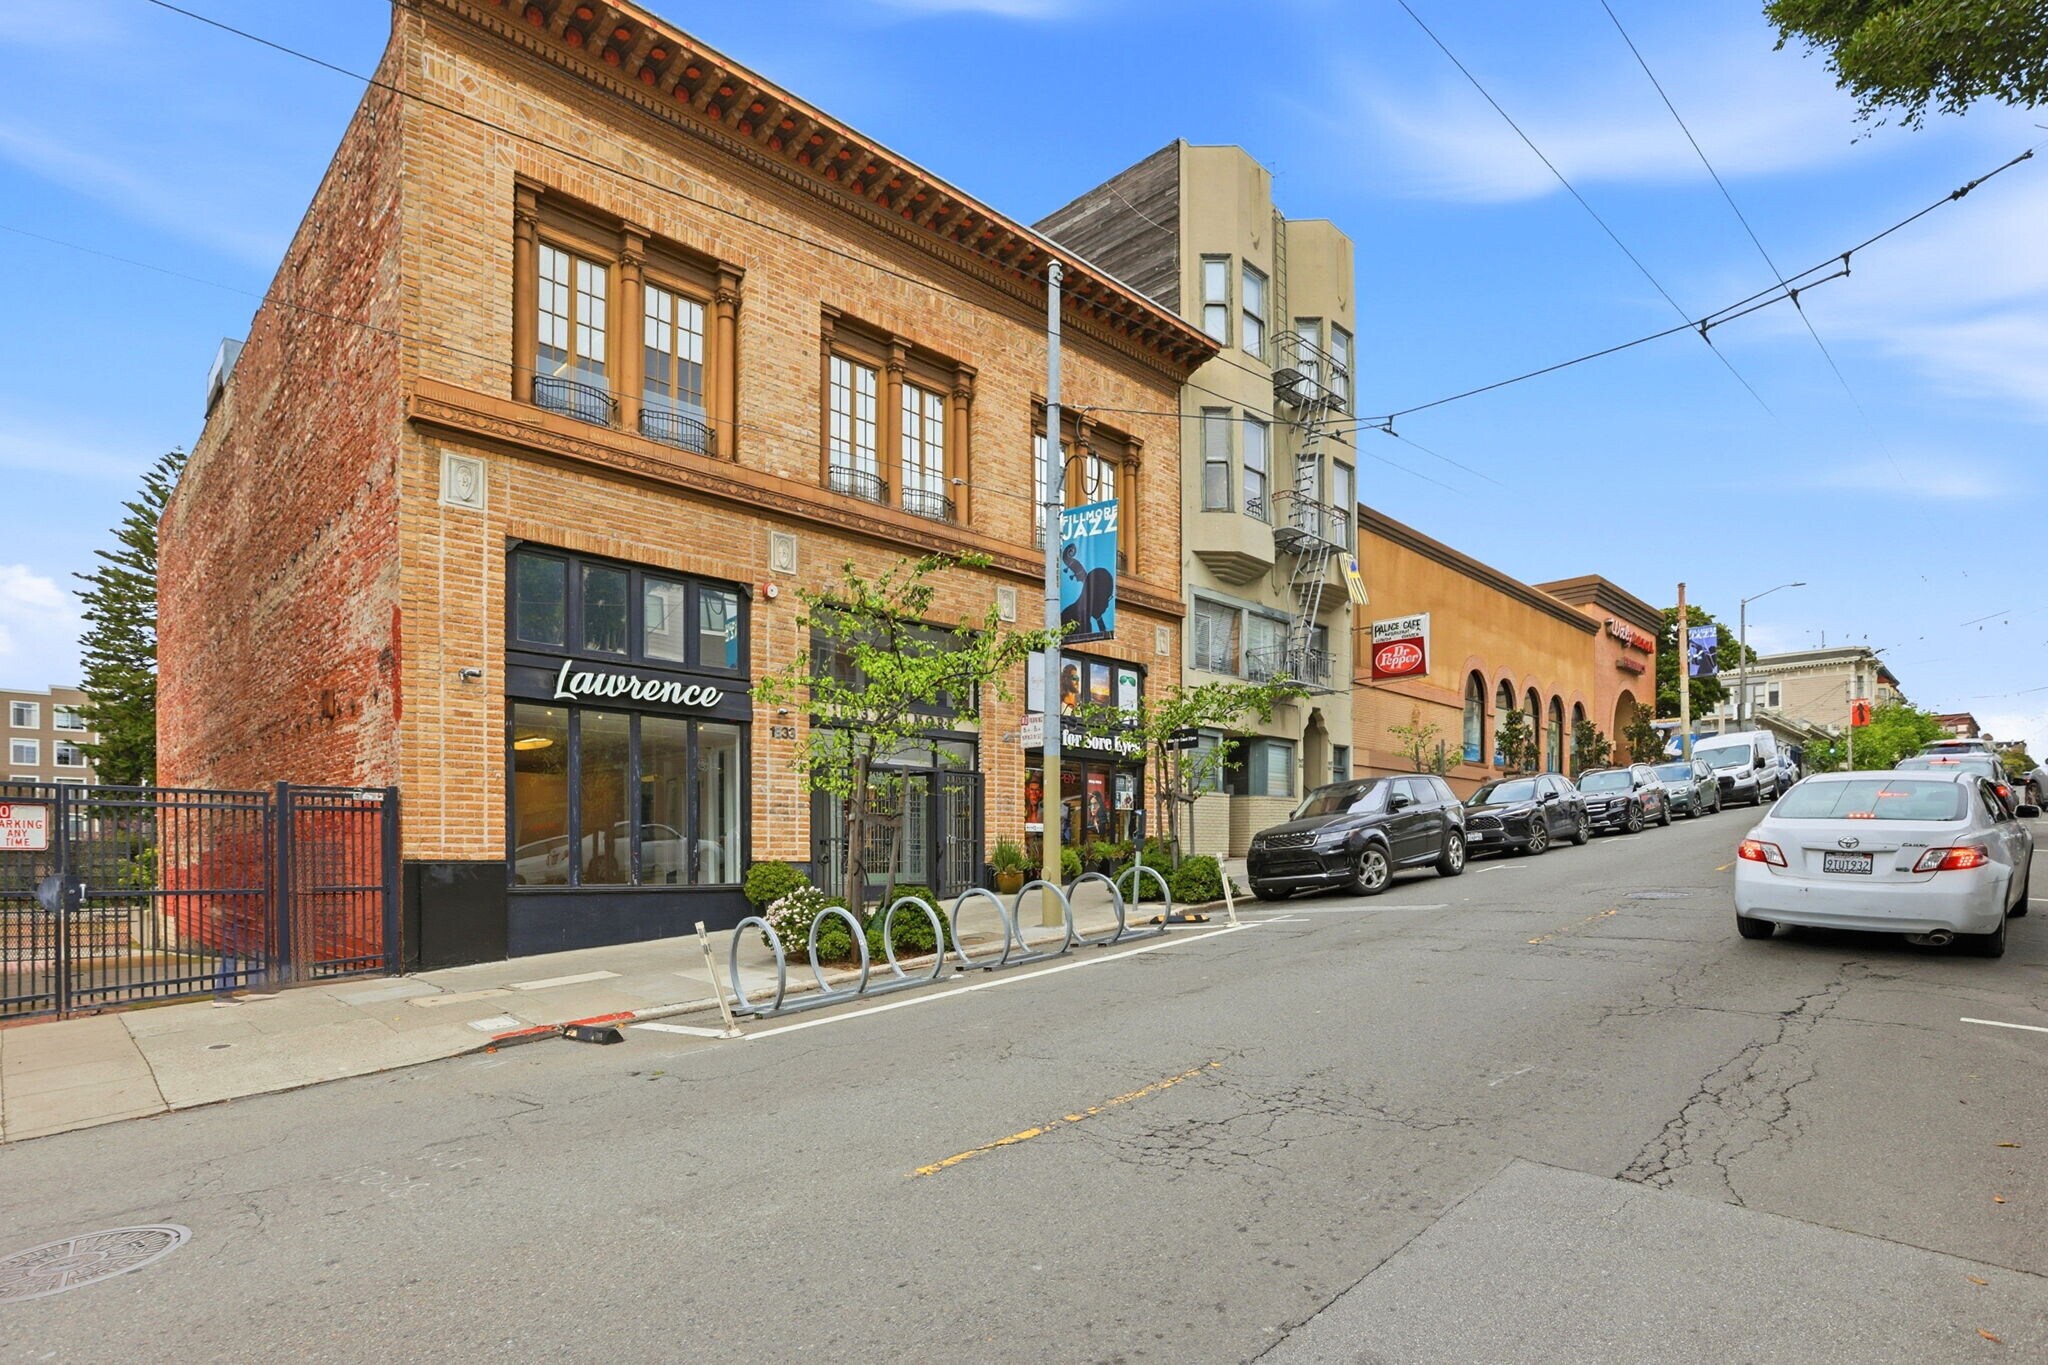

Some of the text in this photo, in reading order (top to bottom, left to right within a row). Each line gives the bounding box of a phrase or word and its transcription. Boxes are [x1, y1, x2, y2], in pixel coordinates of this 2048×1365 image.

[1062, 505, 1118, 524] FILLMORE
[1062, 513, 1118, 541] JAZZ
[1393, 645, 1410, 658] Dr
[1379, 653, 1419, 669] Pepper
[554, 659, 724, 708] Lawrence
[1061, 729, 1082, 748] for
[0, 805, 9, 817] O
[0, 820, 42, 829] ARKING
[6, 838, 30, 846] TIME
